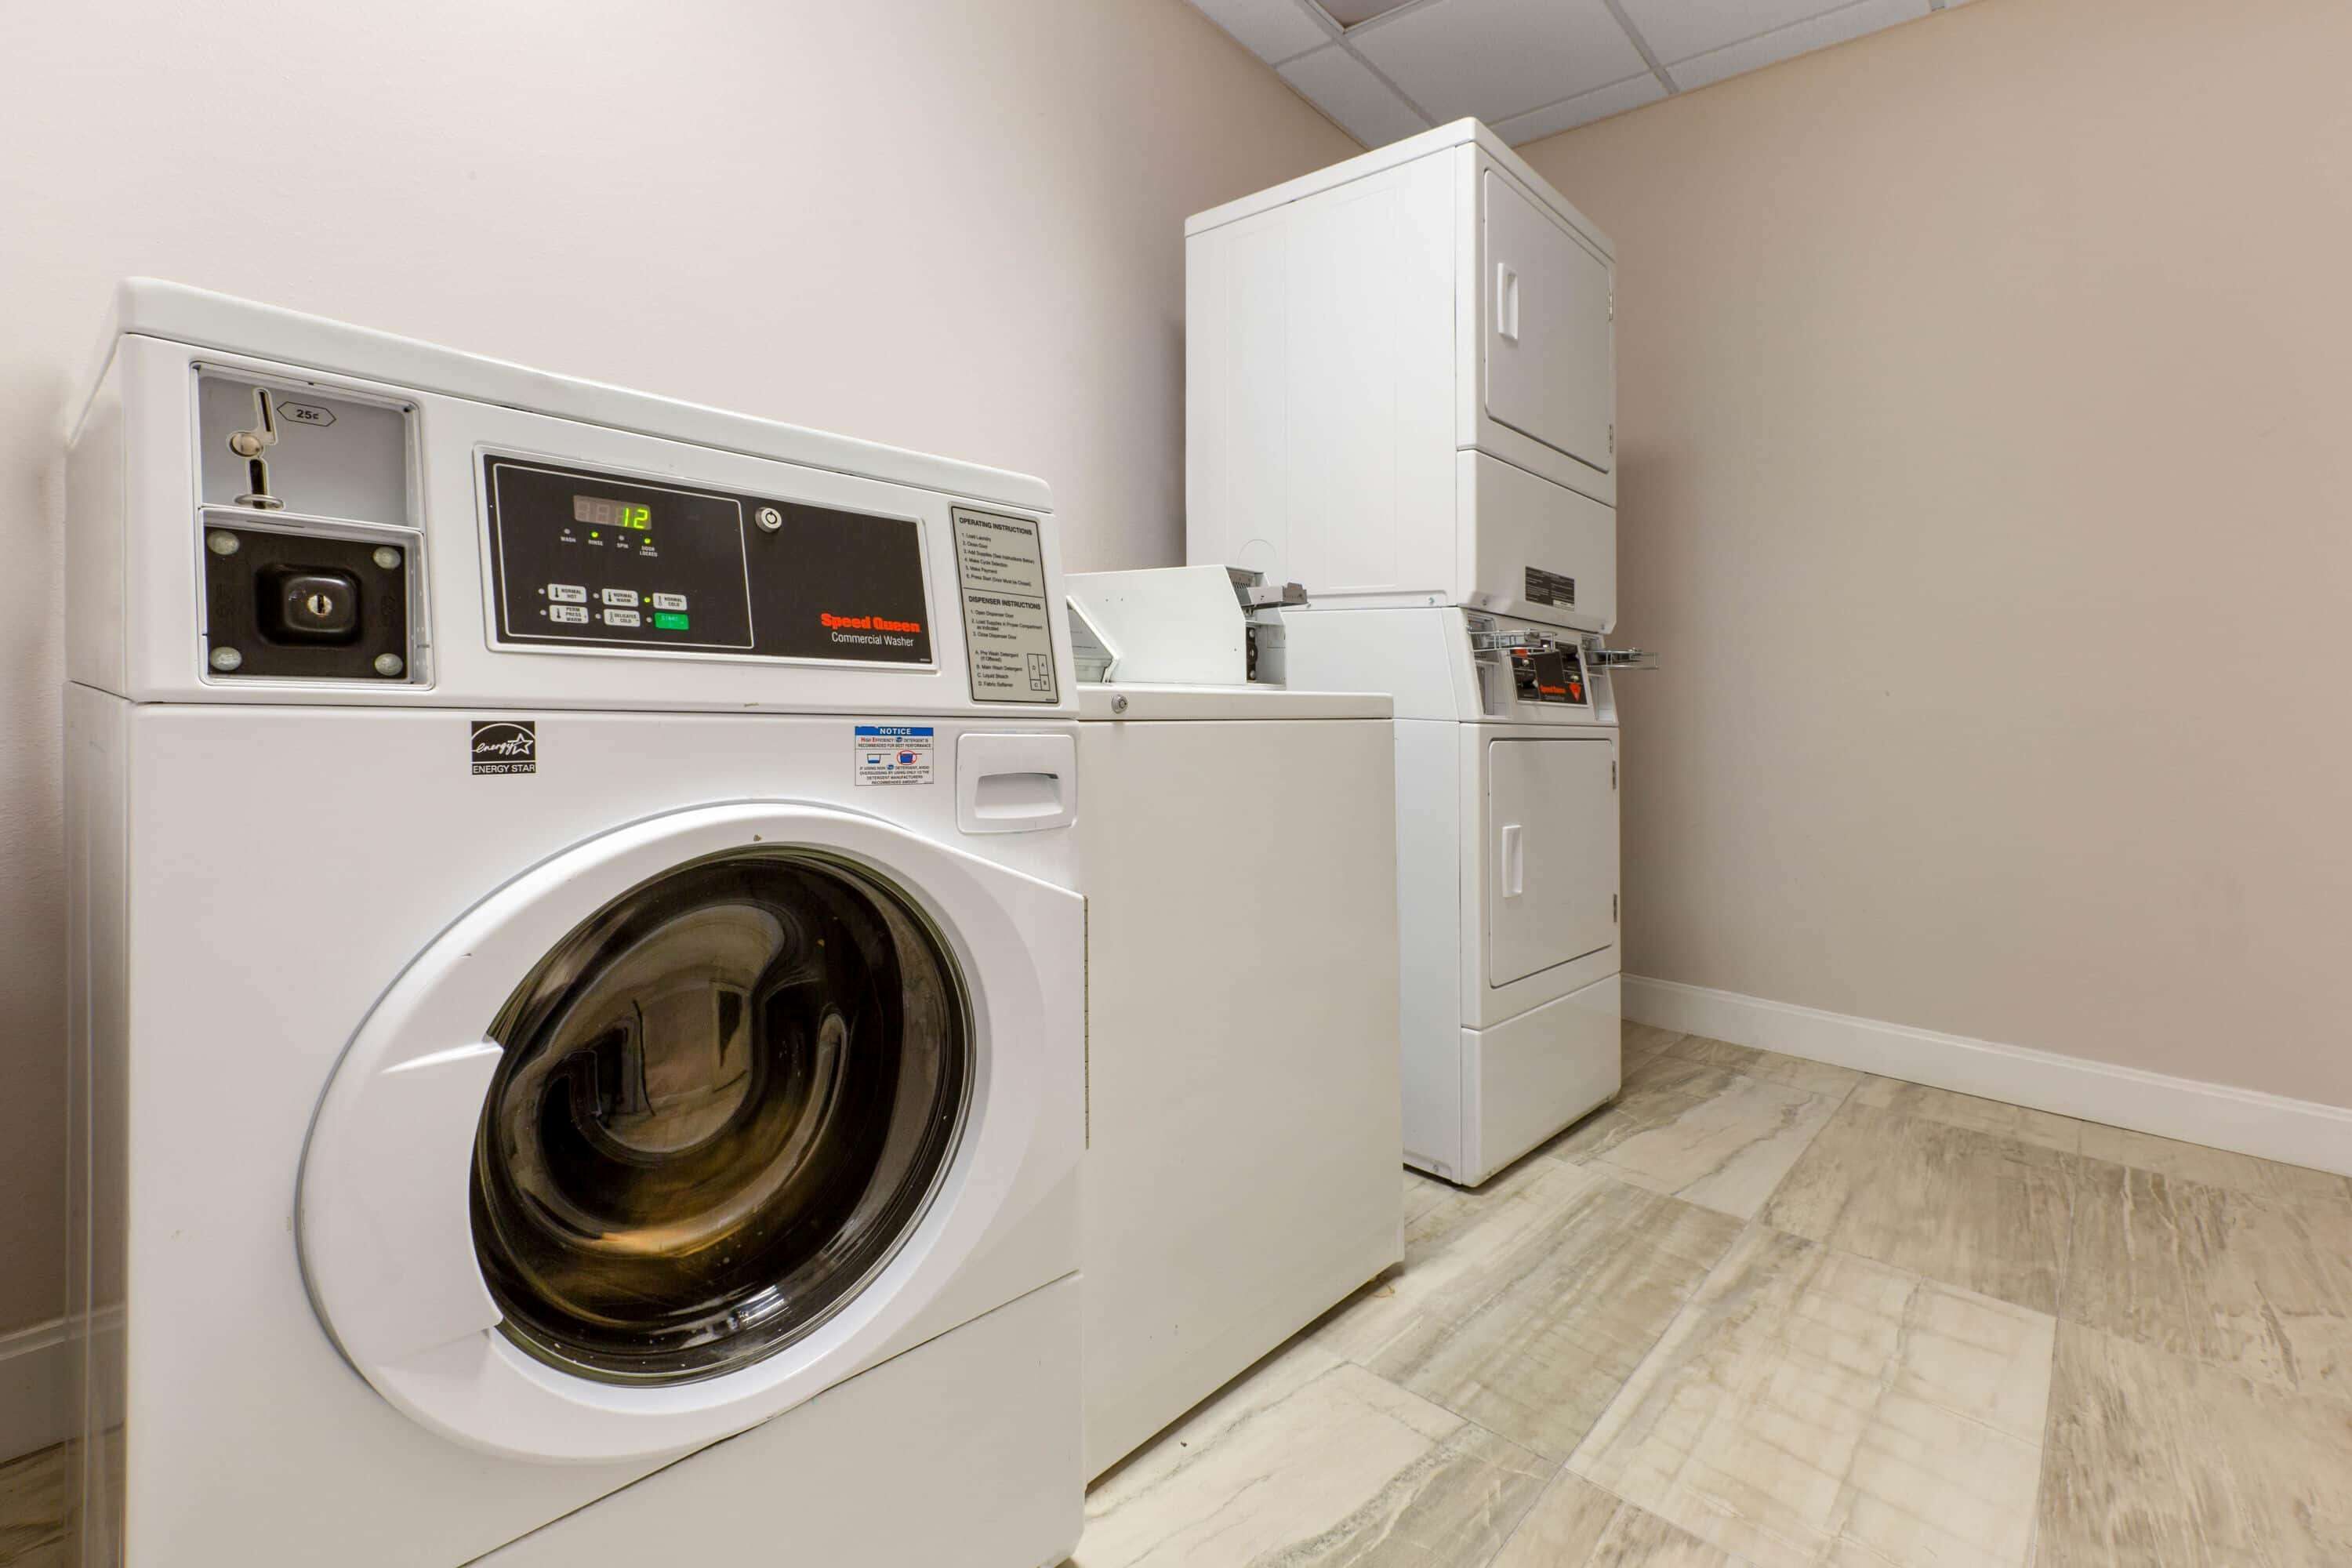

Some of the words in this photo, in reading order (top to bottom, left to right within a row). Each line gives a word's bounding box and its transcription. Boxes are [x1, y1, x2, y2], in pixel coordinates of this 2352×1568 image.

[624, 507, 648, 529] 12
[960, 517, 992, 528] OPERATING
[993, 523, 1033, 535] INSTRUCTIONS
[968, 596, 1001, 605] DISPENSER
[1001, 600, 1041, 610] INSTRUCTIONS
[821, 613, 871, 630] Speed
[873, 617, 920, 633] Queen
[832, 632, 882, 644] Commercial
[884, 635, 914, 646] Washer
[473, 764, 510, 774] ENERGY
[511, 764, 535, 772] STAR
